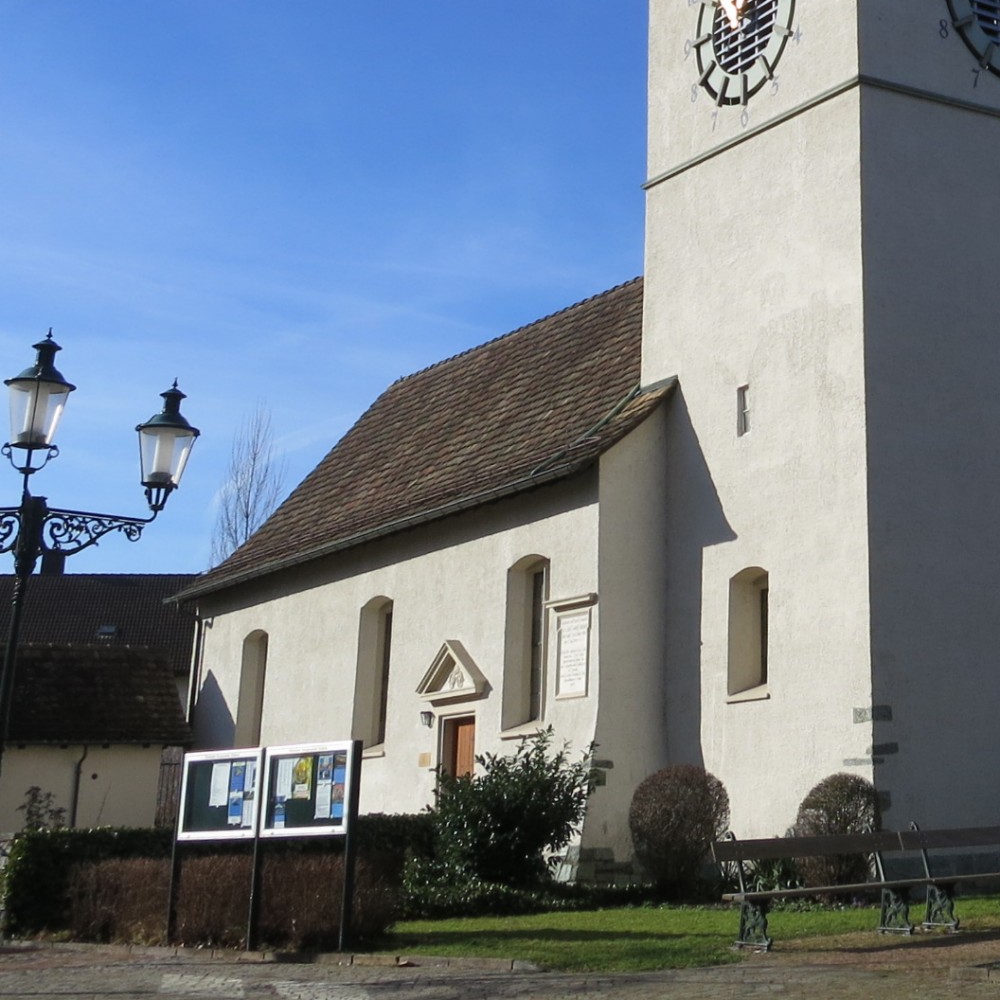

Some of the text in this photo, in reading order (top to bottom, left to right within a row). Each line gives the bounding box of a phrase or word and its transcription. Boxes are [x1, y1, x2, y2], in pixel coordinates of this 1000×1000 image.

[792, 25, 802, 45] 4
[939, 20, 948, 38] 8
[684, 40, 692, 61] 9
[771, 75, 780, 96] 5
[972, 70, 979, 87] 7
[690, 83, 698, 102] 8
[741, 106, 749, 128] 6
